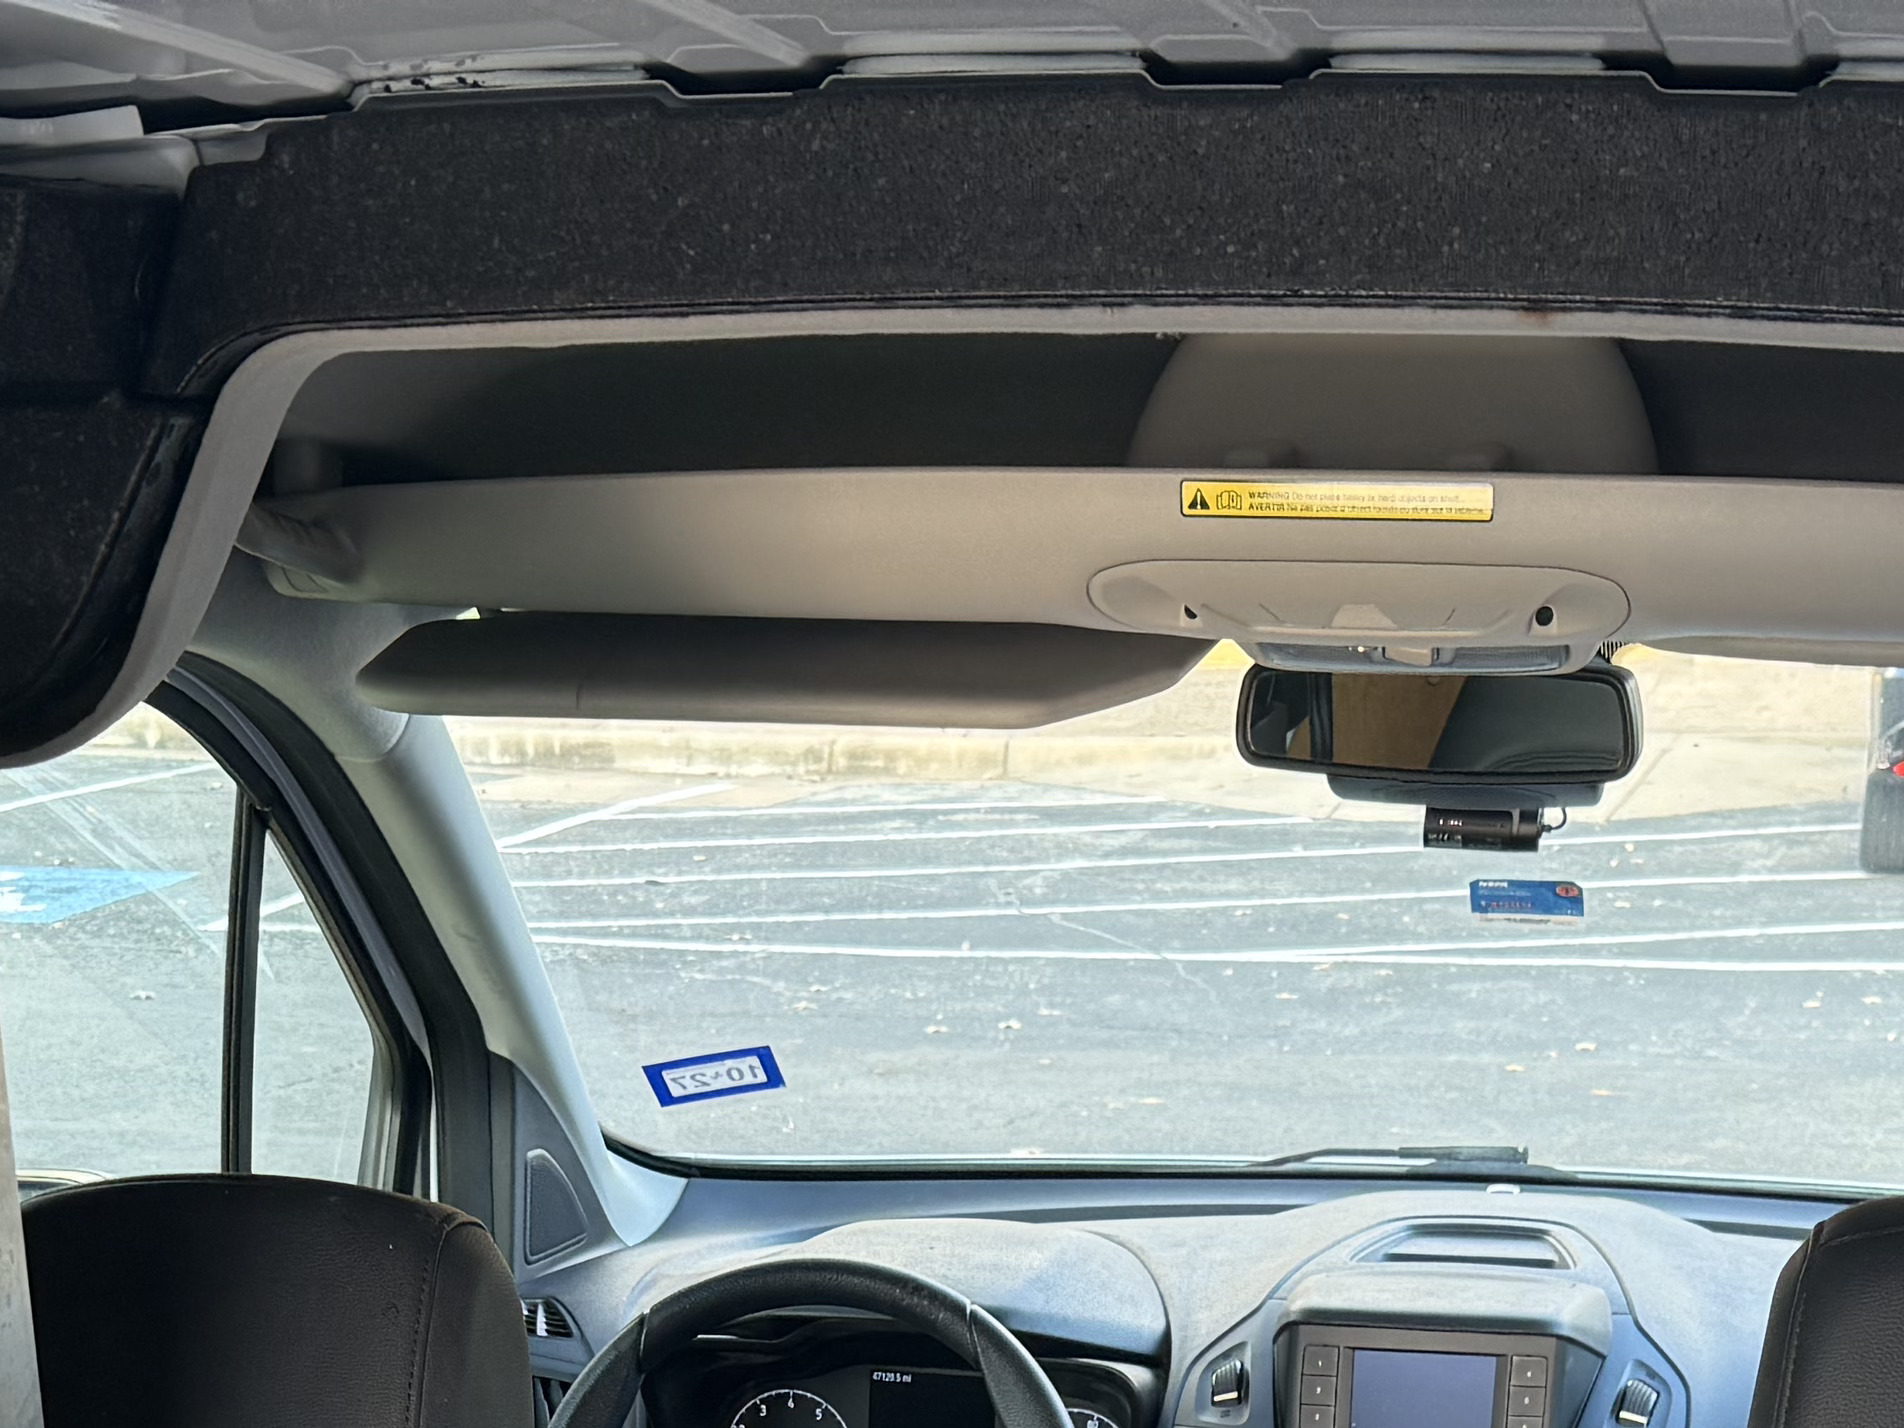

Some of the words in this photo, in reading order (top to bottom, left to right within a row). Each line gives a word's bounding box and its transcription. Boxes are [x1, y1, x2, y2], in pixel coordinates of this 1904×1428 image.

[1248, 491, 1289, 500] WARNING
[787, 1398, 794, 1409] 4
[759, 1404, 767, 1416] 3
[815, 1408, 822, 1420] 5
